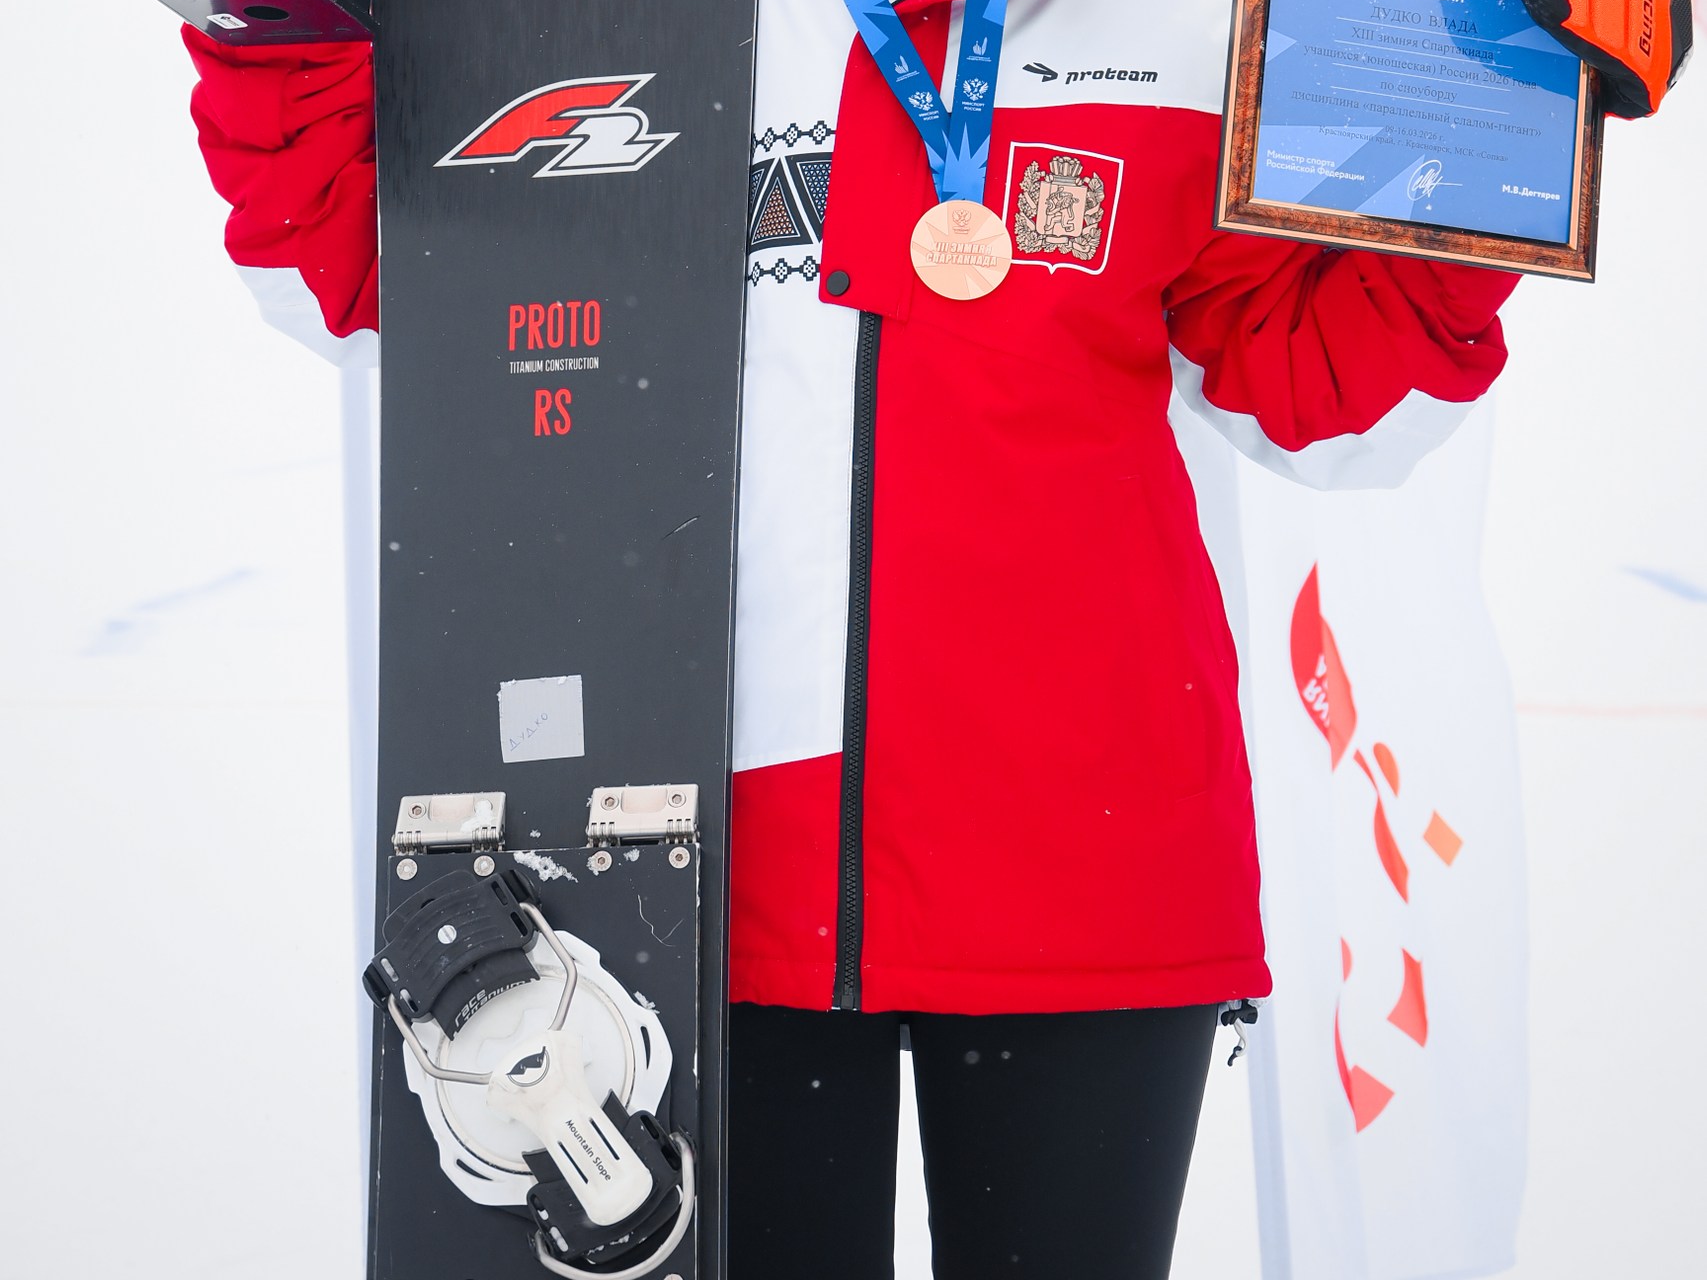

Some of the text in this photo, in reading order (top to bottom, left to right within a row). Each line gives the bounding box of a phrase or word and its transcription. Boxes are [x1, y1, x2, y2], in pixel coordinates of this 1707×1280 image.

[1371, 6, 1478, 34] ДУДКО ВЛАДА
[1351, 26, 1494, 60] XIII зимняя Спартакиада
[1065, 67, 1158, 85] proteam
[1304, 45, 1537, 90] учащихся (юношеская) России 2026 года
[1380, 81, 1458, 102] по сноуборду
[1291, 91, 1541, 137] дисциплина «параллельный слалом-гигант»
[1319, 125, 1373, 142] Красноярский
[1454, 147, 1475, 158] МСК
[1266, 158, 1365, 182] Российской Федерации
[1267, 149, 1335, 168] Министр спорта
[926, 253, 998, 268] СПАРТАКИАДА
[508, 300, 601, 351] PROTO
[509, 356, 599, 375] TITANIUM CONSTRUCTION
[534, 387, 572, 437] RS
[455, 989, 486, 1027] race
[565, 1119, 612, 1181] Mountain Slope
